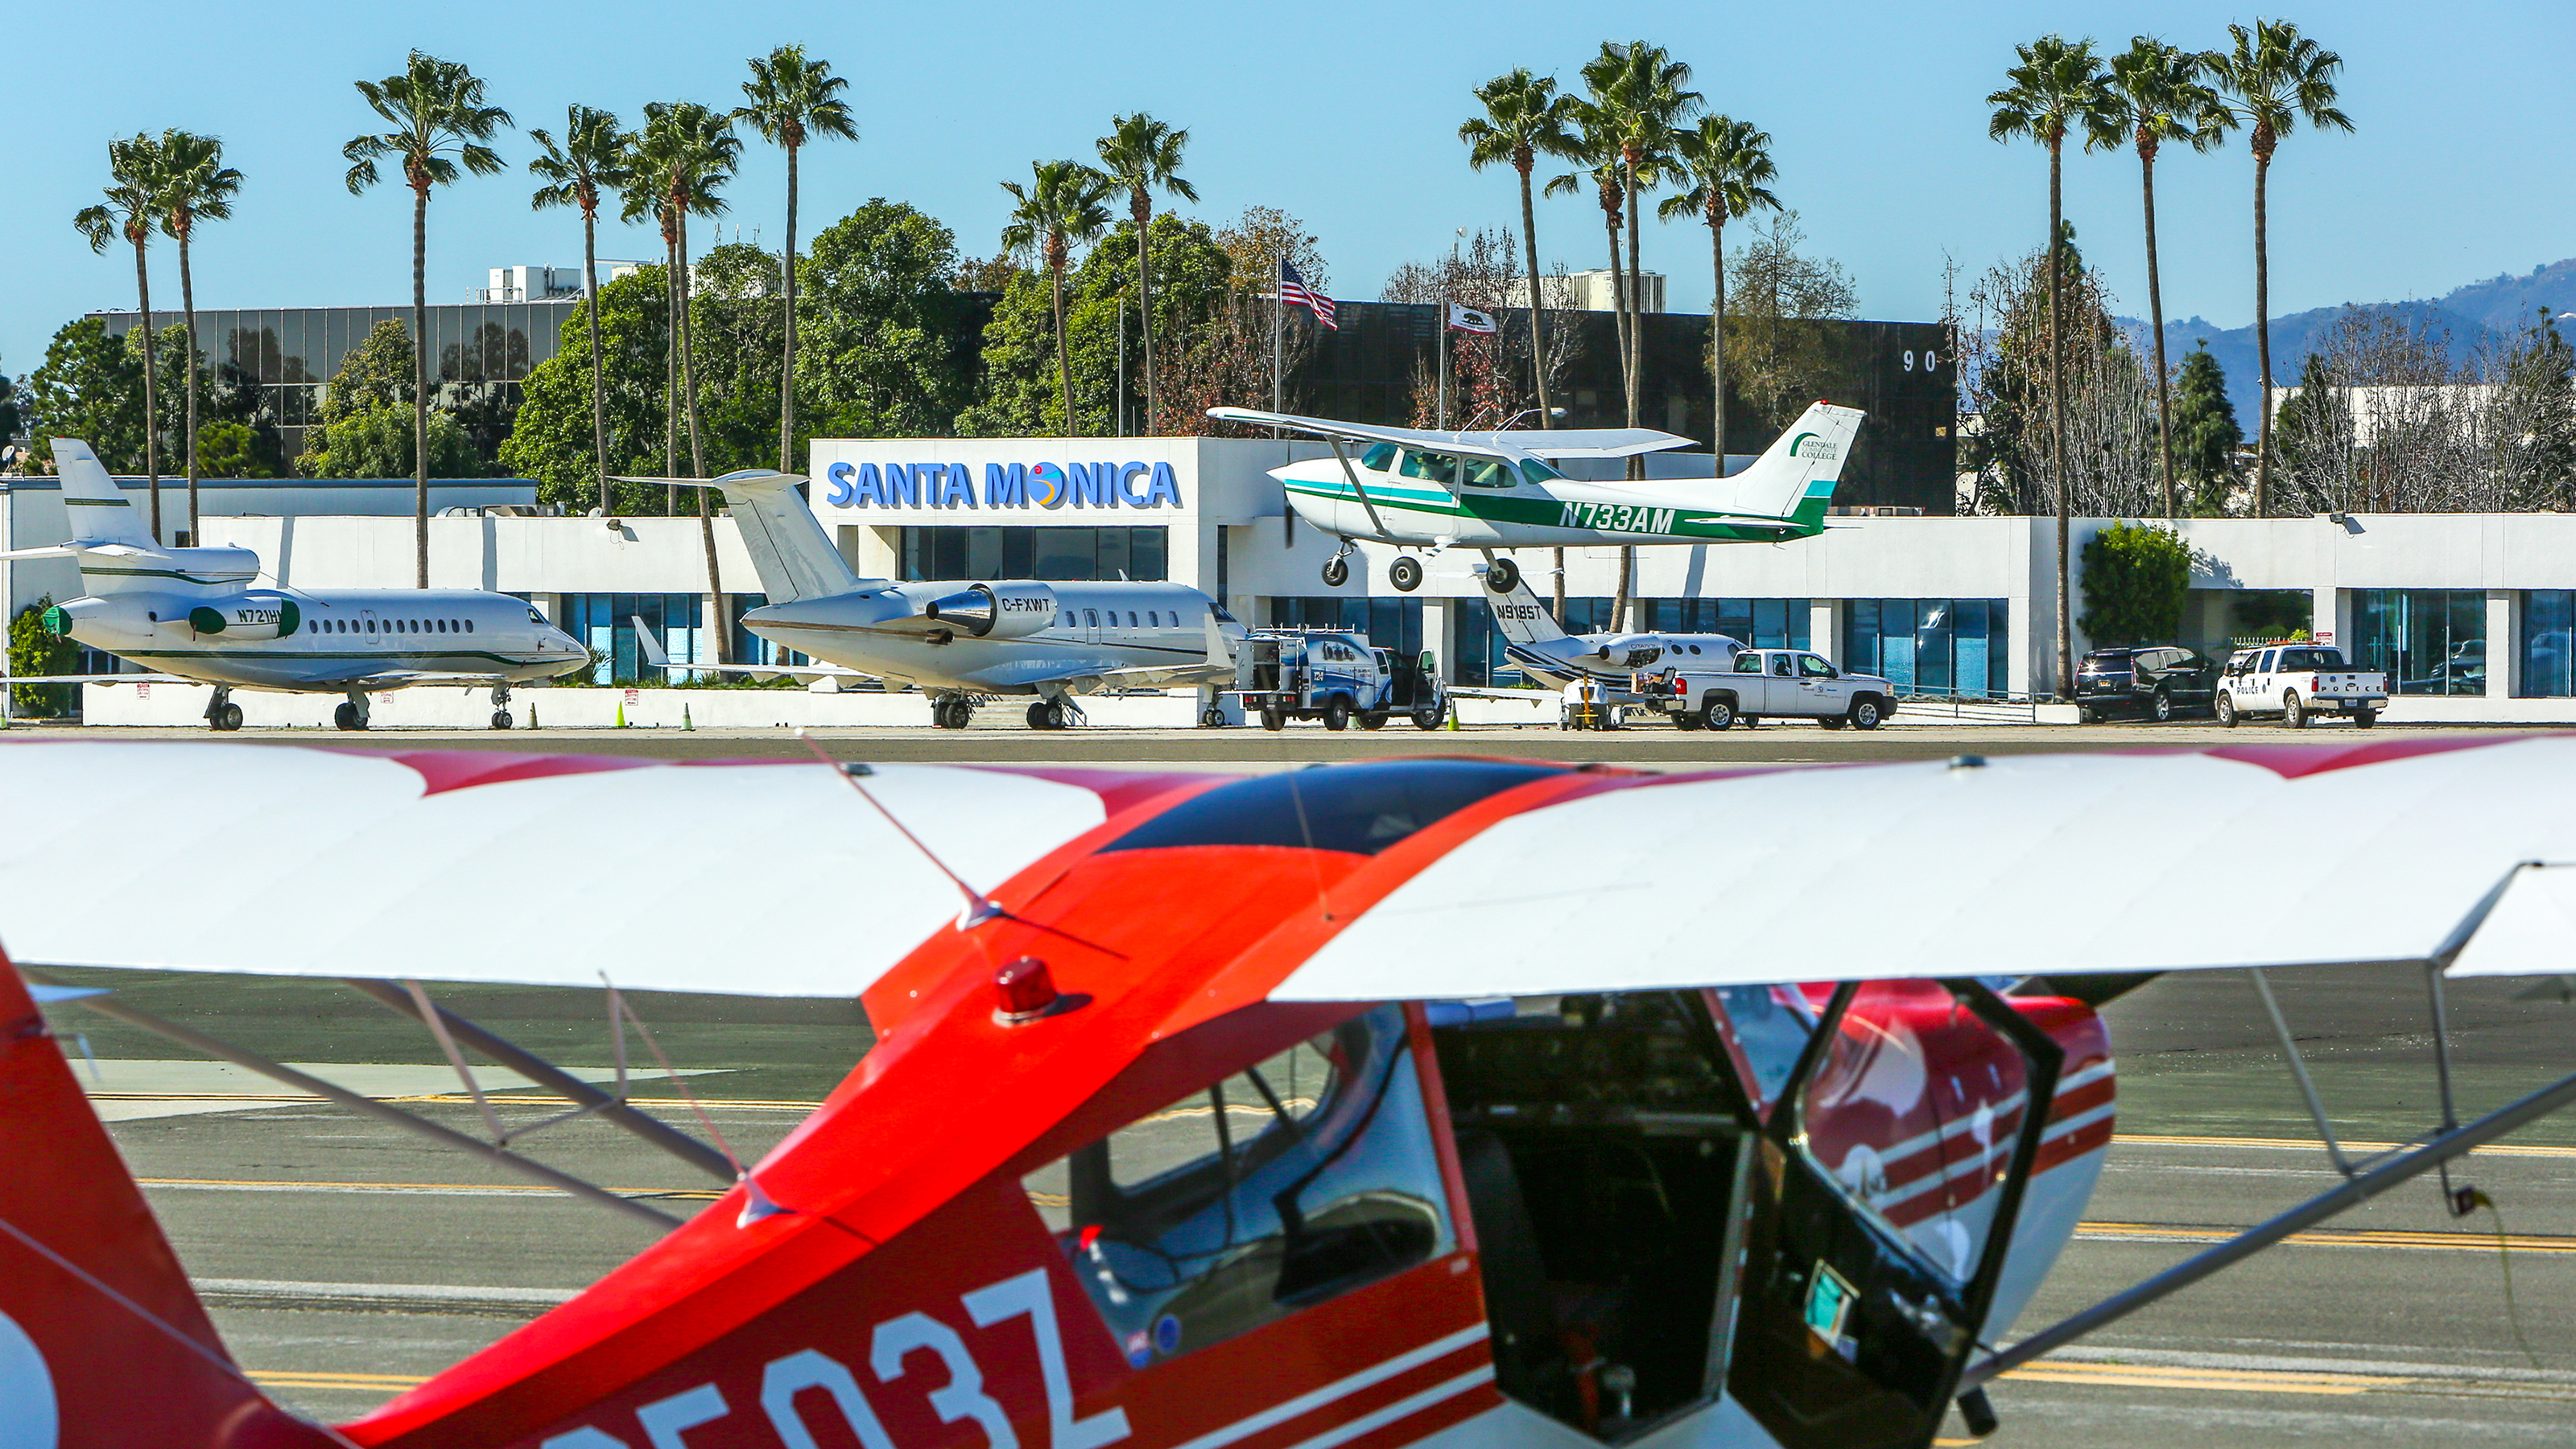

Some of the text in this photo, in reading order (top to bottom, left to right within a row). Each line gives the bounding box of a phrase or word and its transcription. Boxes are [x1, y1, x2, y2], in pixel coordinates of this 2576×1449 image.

[1802, 440, 1838, 449] GLENDALE
[1802, 452, 1837, 460] COLLEGE
[827, 461, 1179, 507] SANTA MONICA
[1558, 502, 1676, 535] N733AM
[1001, 597, 1050, 612] C-FXWT
[1496, 605, 1541, 620] N918ST
[2236, 686, 2259, 695] POLICE
